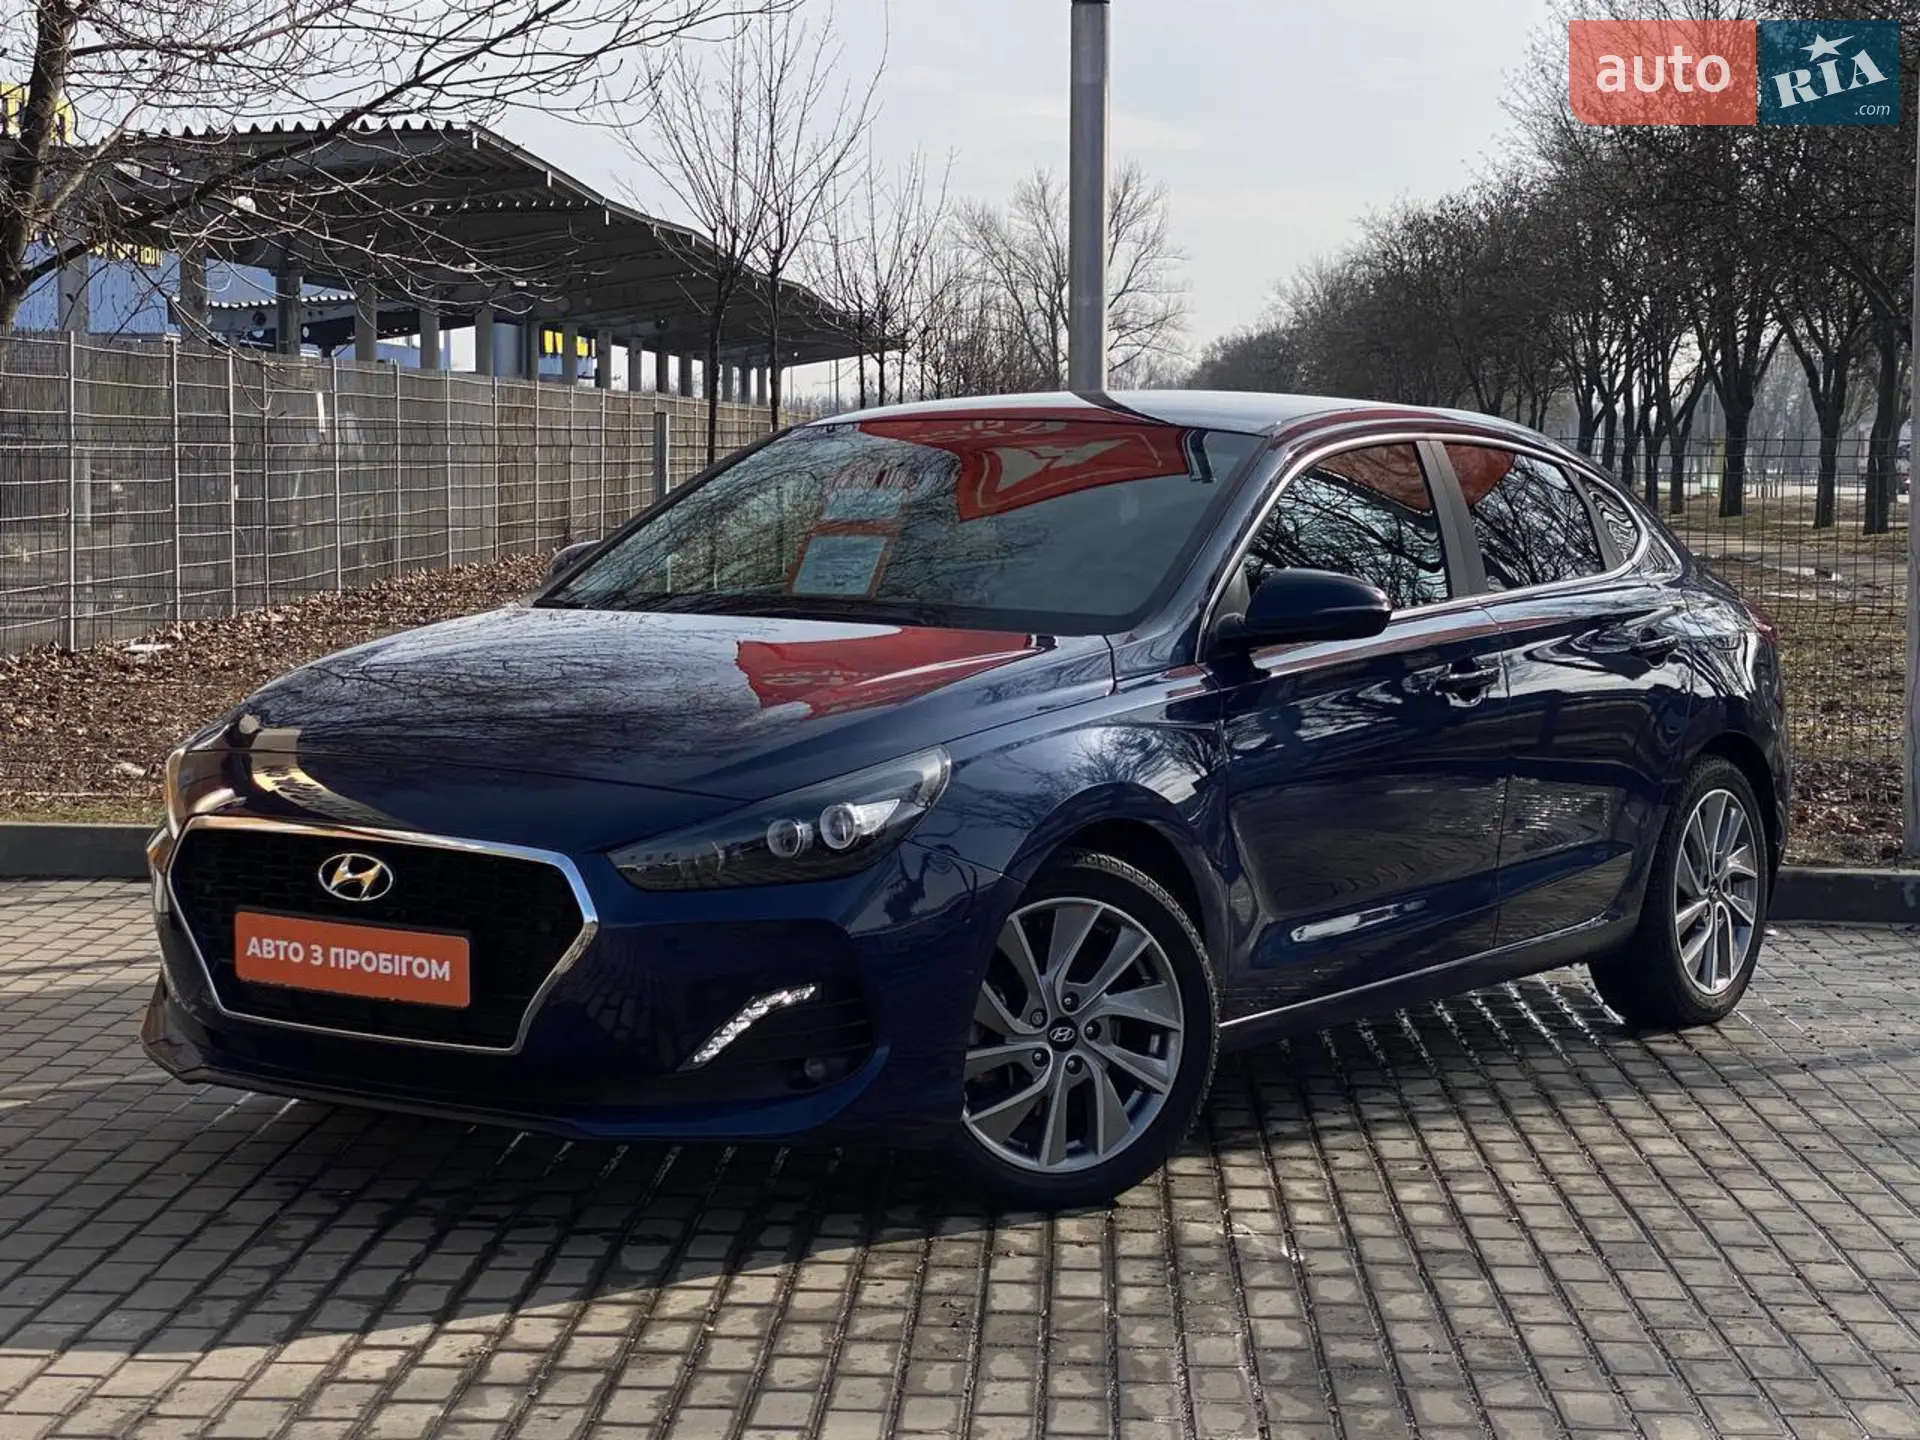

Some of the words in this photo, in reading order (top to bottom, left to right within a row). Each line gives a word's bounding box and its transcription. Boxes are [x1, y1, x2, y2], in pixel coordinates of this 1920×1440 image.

[246, 936, 304, 963] АВТО
[309, 944, 324, 966] З
[329, 947, 451, 982] ПРОБІГОМ
